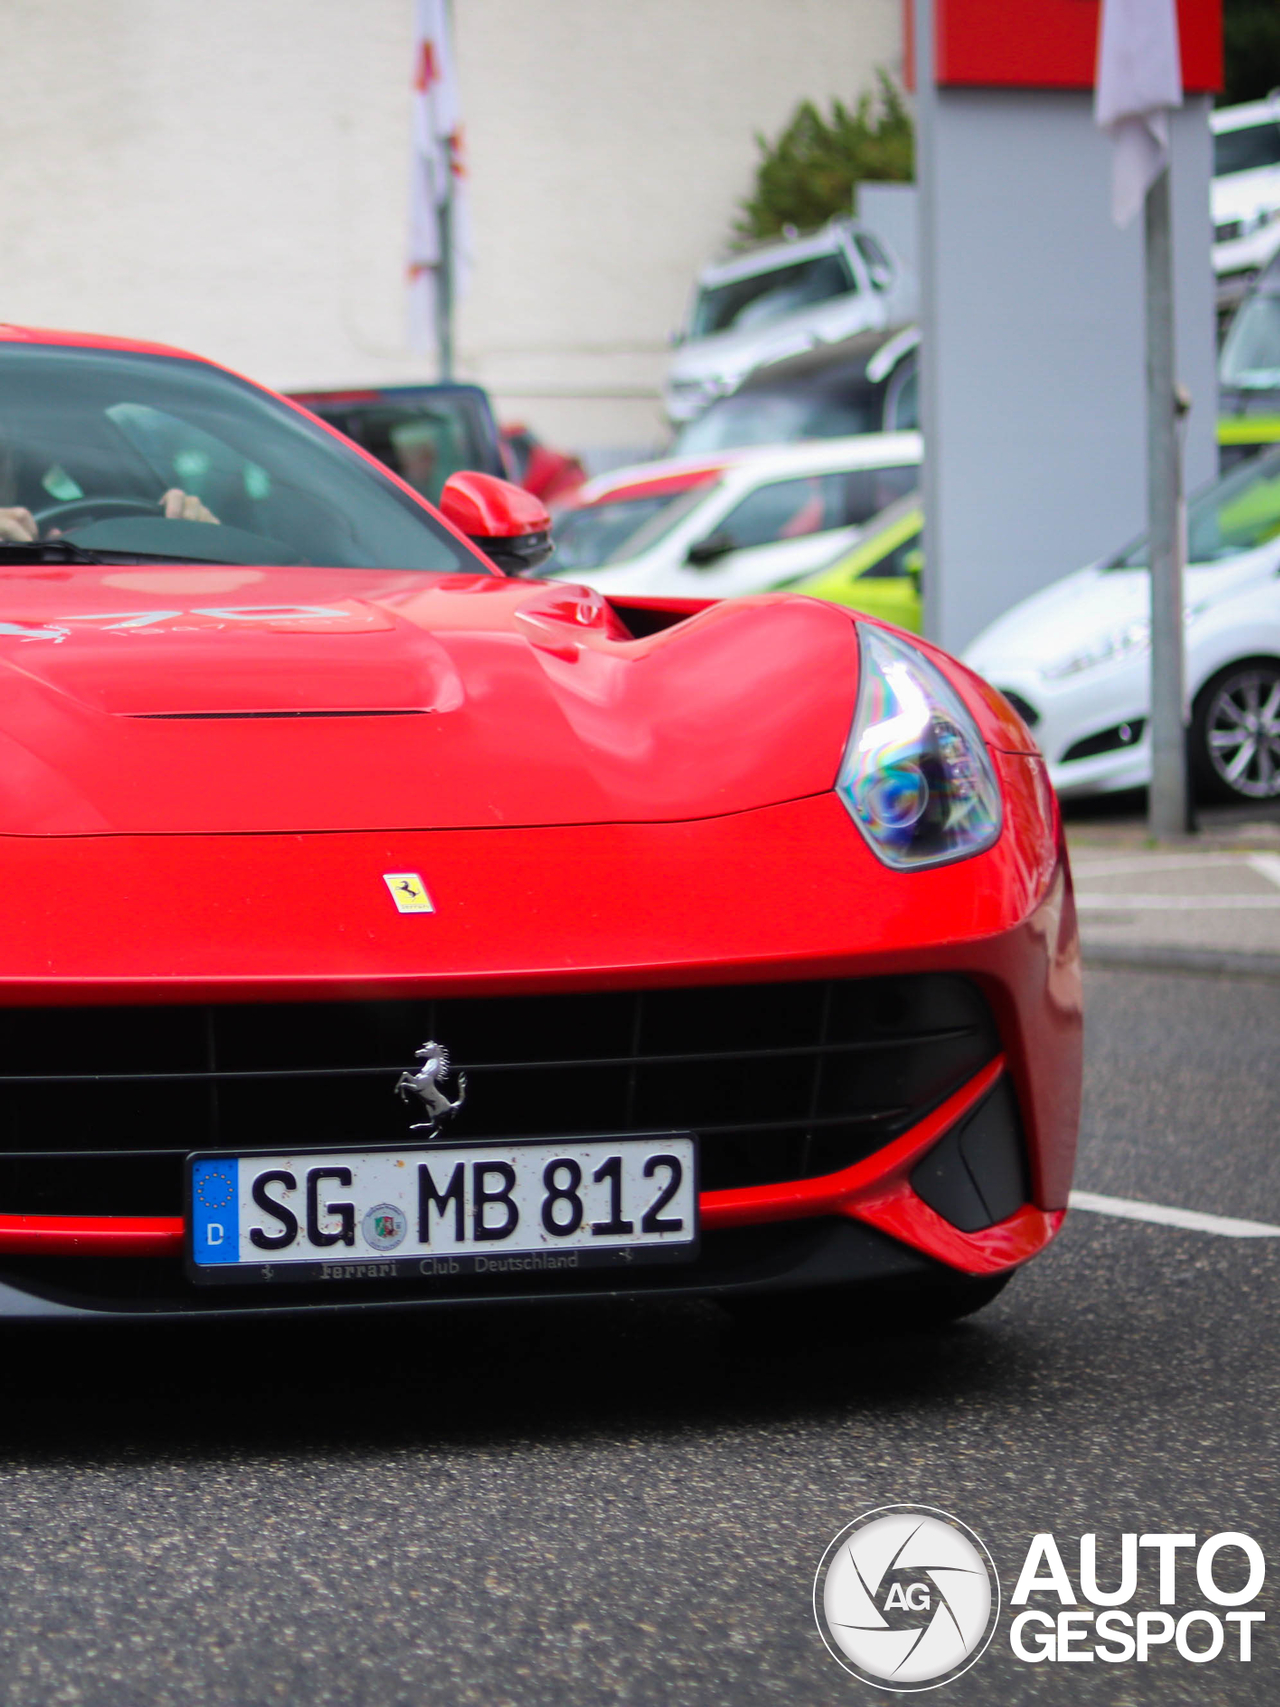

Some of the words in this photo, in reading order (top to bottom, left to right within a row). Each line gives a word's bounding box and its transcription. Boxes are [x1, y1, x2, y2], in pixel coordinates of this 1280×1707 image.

[55, 605, 350, 630] 70
[206, 1222, 224, 1246] D
[249, 1165, 356, 1250] SG
[417, 1159, 520, 1244] MB
[540, 1153, 684, 1237] 812
[320, 1260, 397, 1279] Ferrari
[420, 1257, 460, 1276] Club
[474, 1251, 579, 1274] Deutschland
